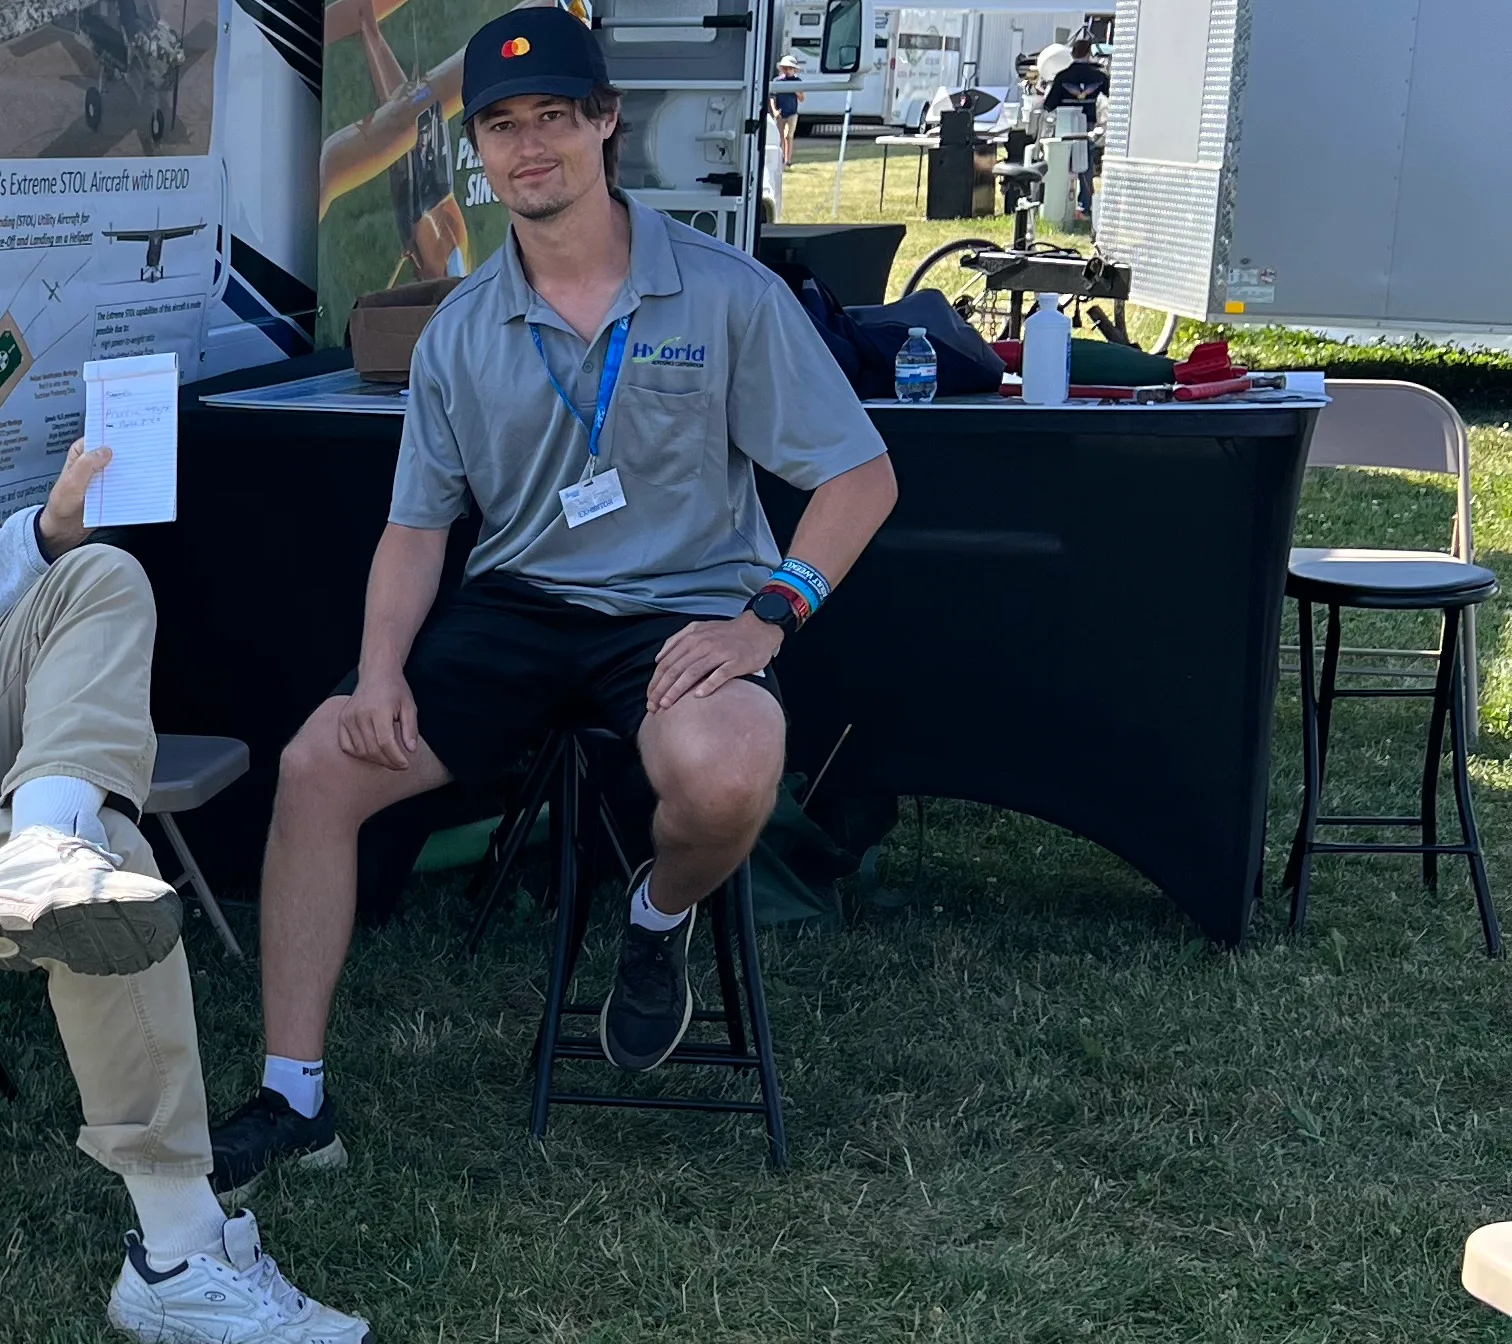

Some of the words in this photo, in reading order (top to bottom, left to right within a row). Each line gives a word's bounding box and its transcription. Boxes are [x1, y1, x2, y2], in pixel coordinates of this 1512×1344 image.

[10, 173, 57, 196] Extreme
[59, 171, 88, 194] STOL
[89, 169, 130, 193] Aircraft
[132, 168, 154, 191] with
[156, 169, 189, 191] DEPOD
[57, 212, 80, 226] Aircraft
[80, 212, 90, 226] for
[16, 233, 29, 246] and
[29, 233, 54, 247] Landing
[69, 231, 93, 244] Heliport
[97, 312, 105, 320] The
[631, 340, 705, 362] Hybrid
[782, 561, 814, 579] WEEKLY
